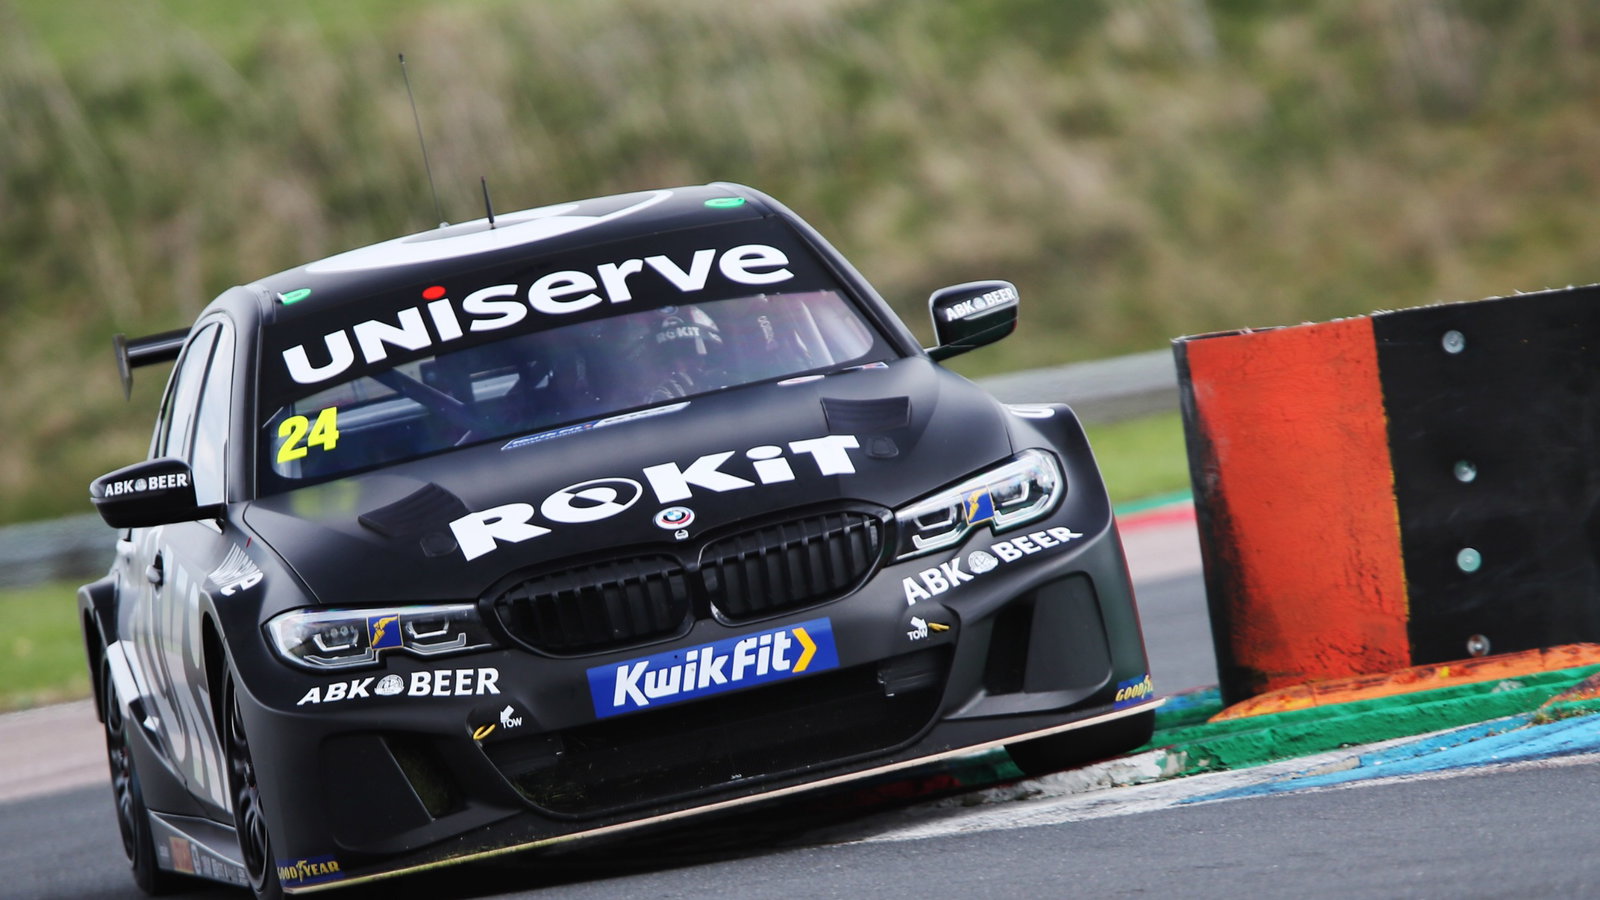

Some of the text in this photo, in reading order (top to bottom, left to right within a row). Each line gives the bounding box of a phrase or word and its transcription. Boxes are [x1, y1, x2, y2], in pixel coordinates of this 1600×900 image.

[945, 287, 1016, 322] ABK BEER
[276, 406, 340, 464] 24
[104, 473, 188, 497] ABK BEER
[902, 526, 1084, 607] ABK BEER
[907, 627, 929, 641] TOW
[296, 667, 501, 706] ABK BEER
[501, 716, 523, 729] TOW
